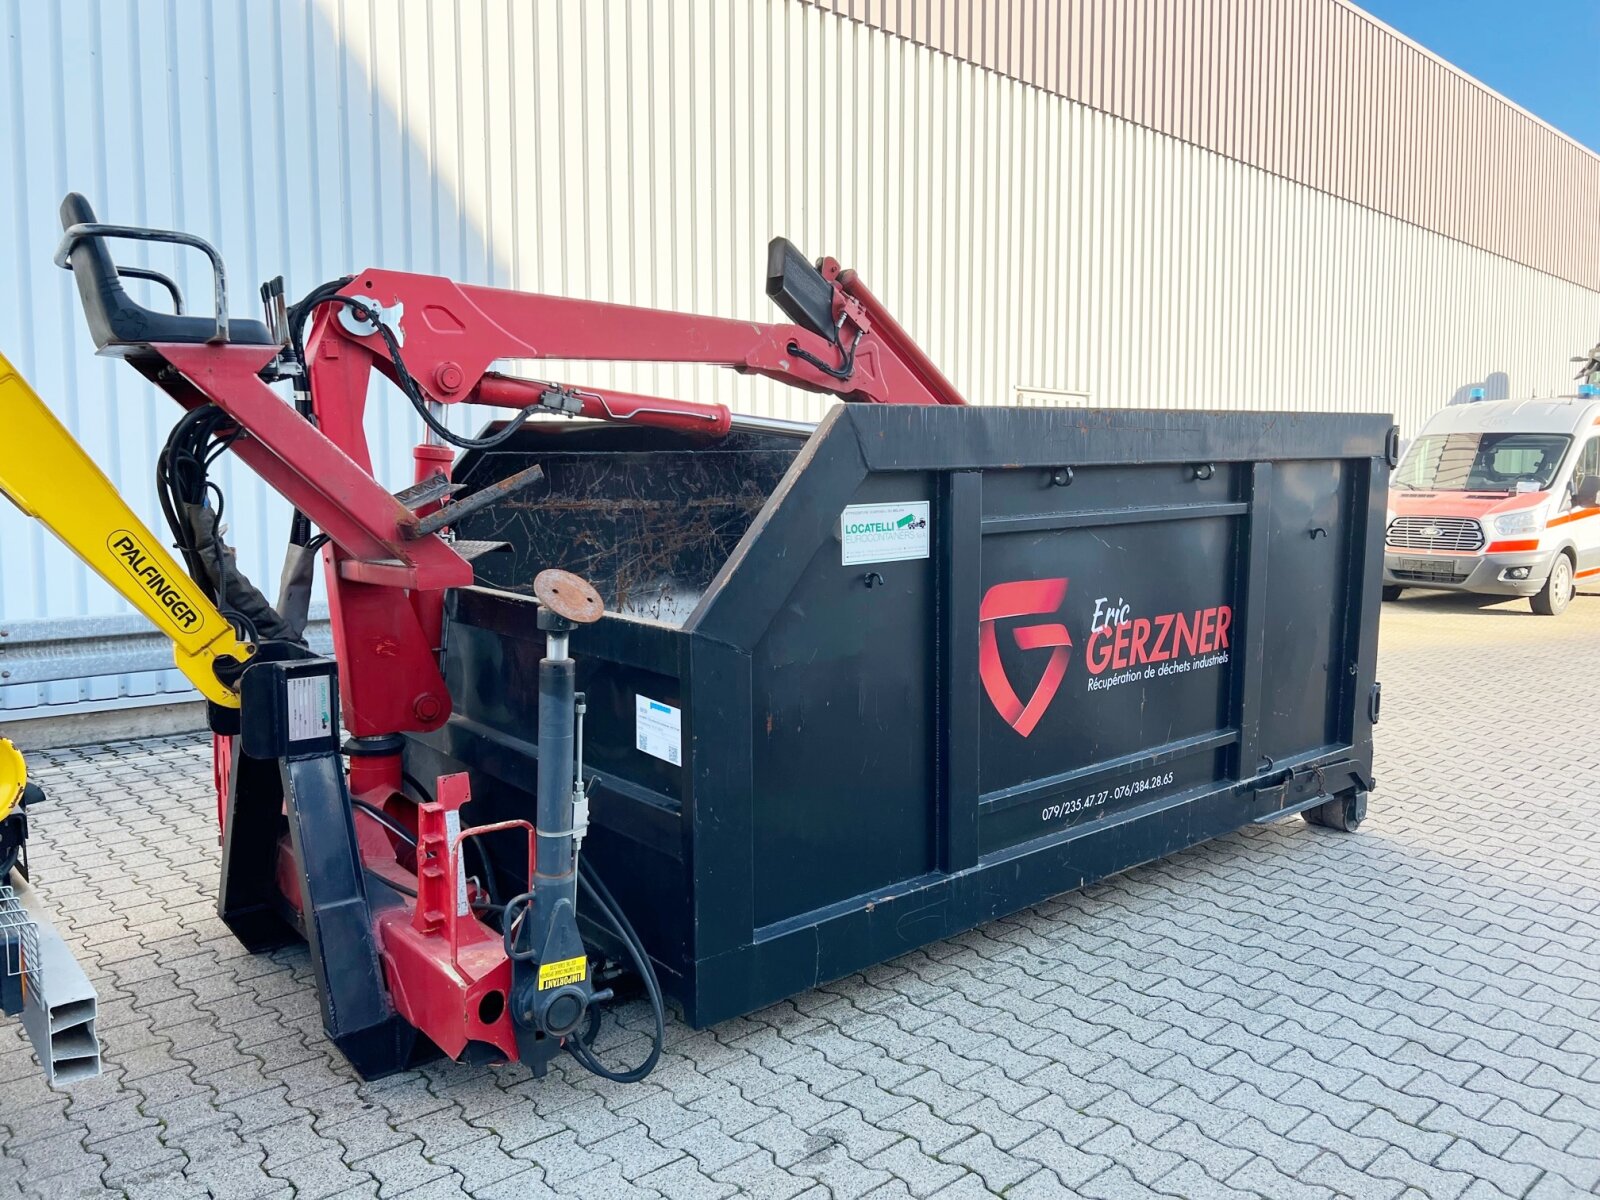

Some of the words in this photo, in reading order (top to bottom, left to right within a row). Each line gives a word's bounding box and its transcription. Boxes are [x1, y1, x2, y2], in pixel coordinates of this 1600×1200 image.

[845, 521, 895, 534] LOCATELLI
[845, 531, 915, 544] EUROCONTAINERS
[113, 536, 197, 628] PALFINGER
[1091, 597, 1130, 633] Eric
[1086, 605, 1232, 675] GERZNER
[1087, 669, 1142, 692] Récupération
[1144, 665, 1155, 679] de
[1158, 660, 1191, 676] déchets
[1192, 651, 1229, 669] industriels
[1042, 790, 1109, 820] 079/235.47.27
[1114, 772, 1174, 799] 076/384.28.65
[544, 973, 580, 990] IMPORTANT
